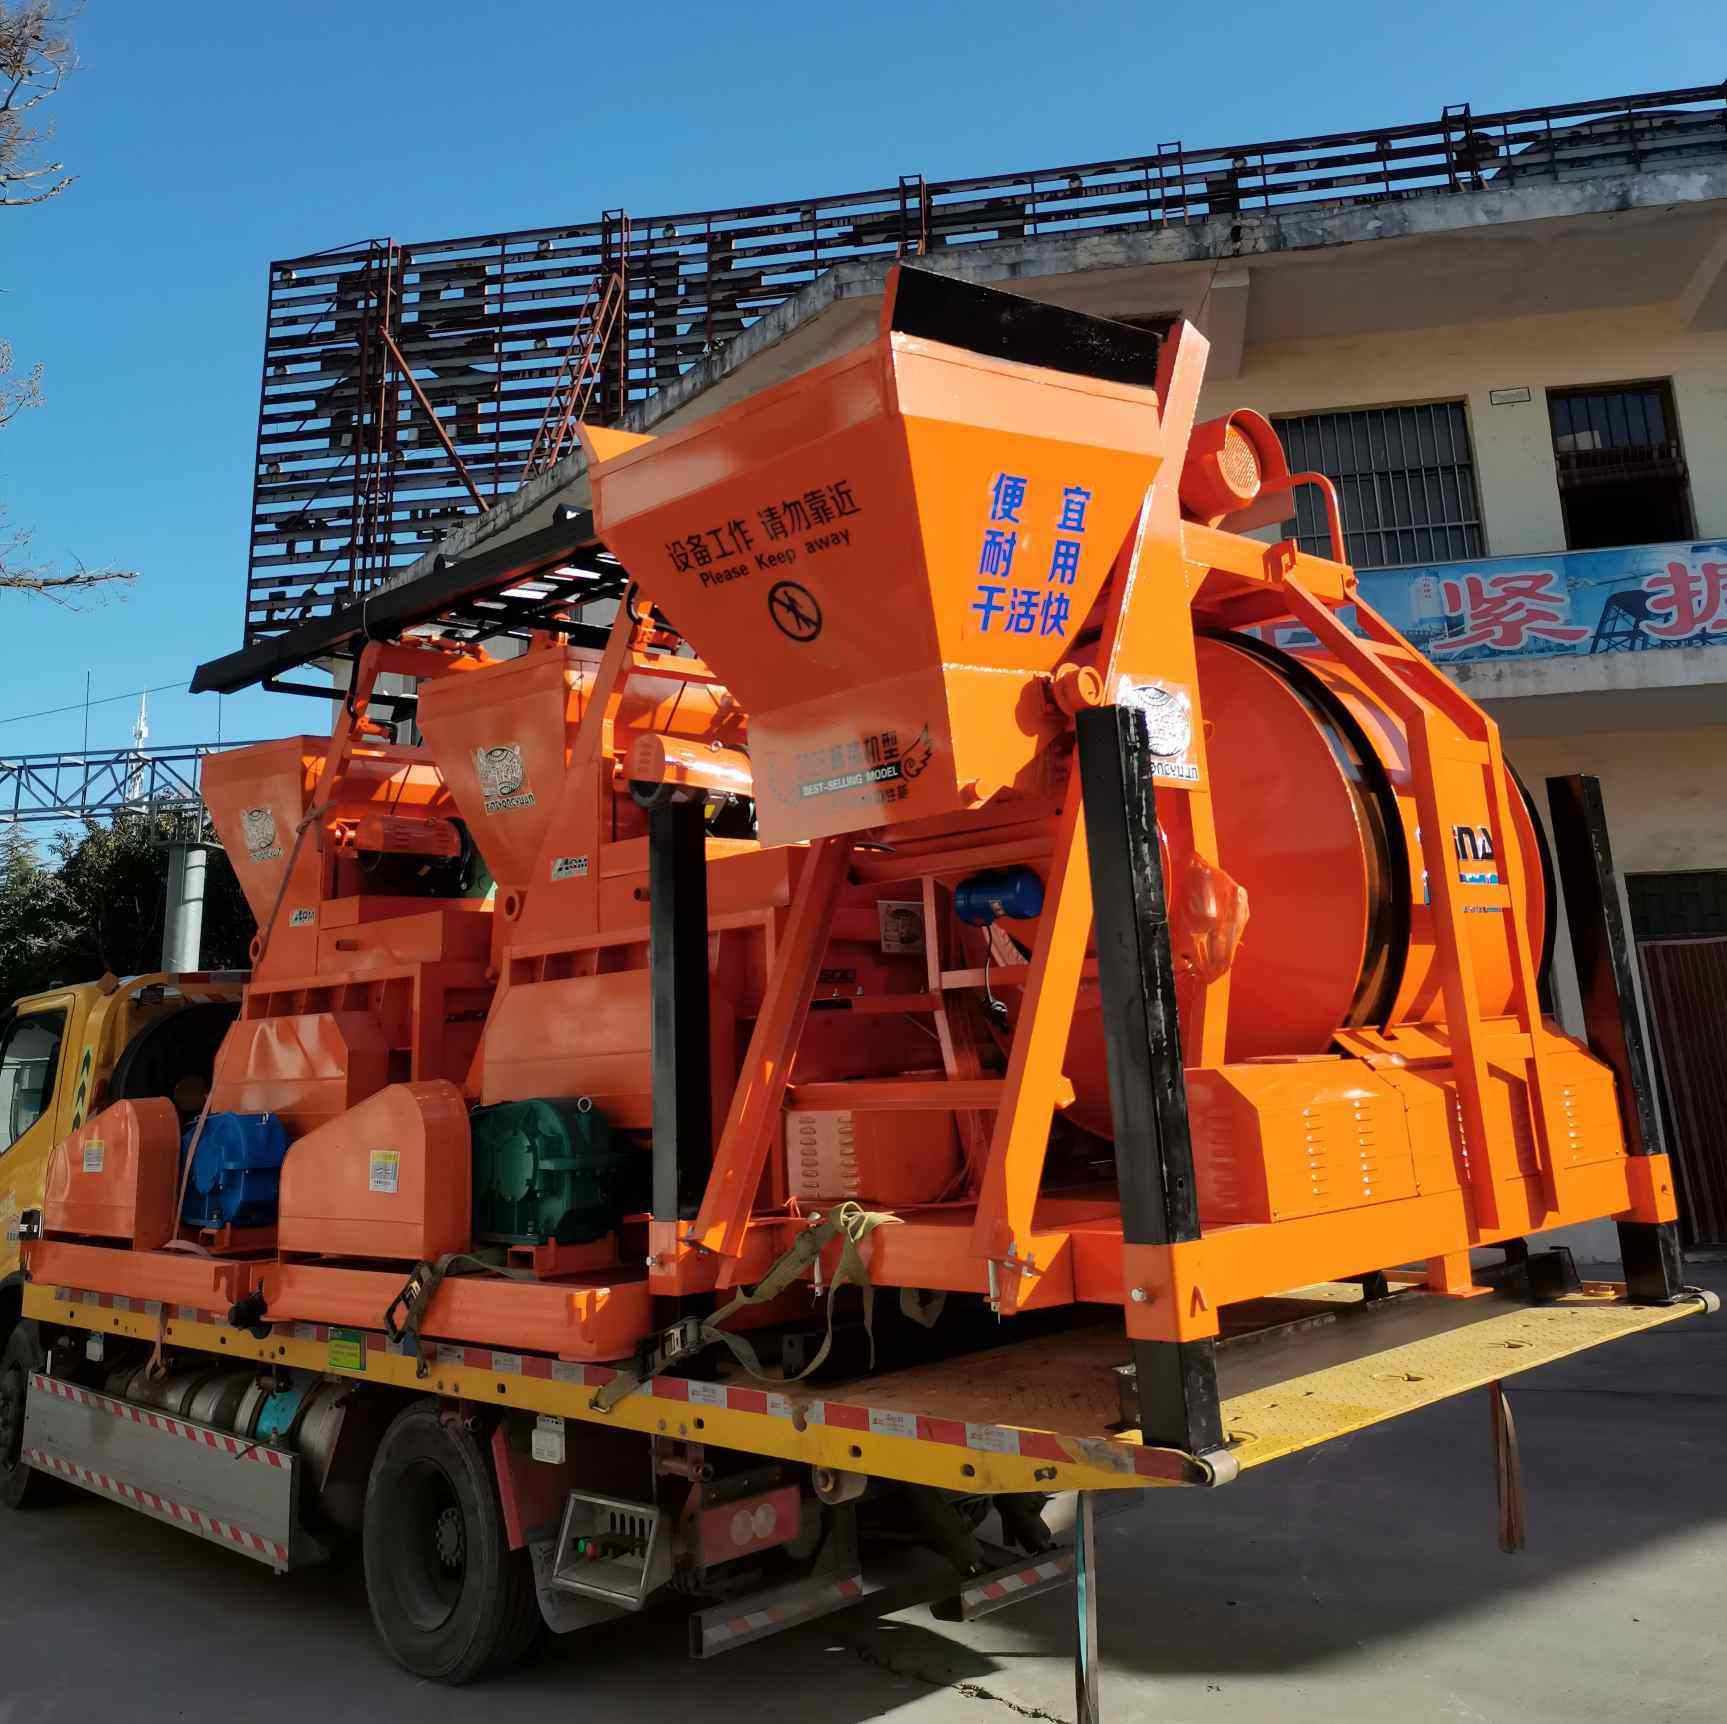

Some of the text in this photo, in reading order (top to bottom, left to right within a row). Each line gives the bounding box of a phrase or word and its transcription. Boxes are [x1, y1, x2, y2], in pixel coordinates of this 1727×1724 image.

[665, 479, 862, 573] 设备工作 请勿靠近
[699, 527, 851, 588] Please Keep away
[972, 585, 1070, 637] 干活快
[801, 773, 863, 796] BEST-SELLING
[865, 765, 899, 783] MODEL
